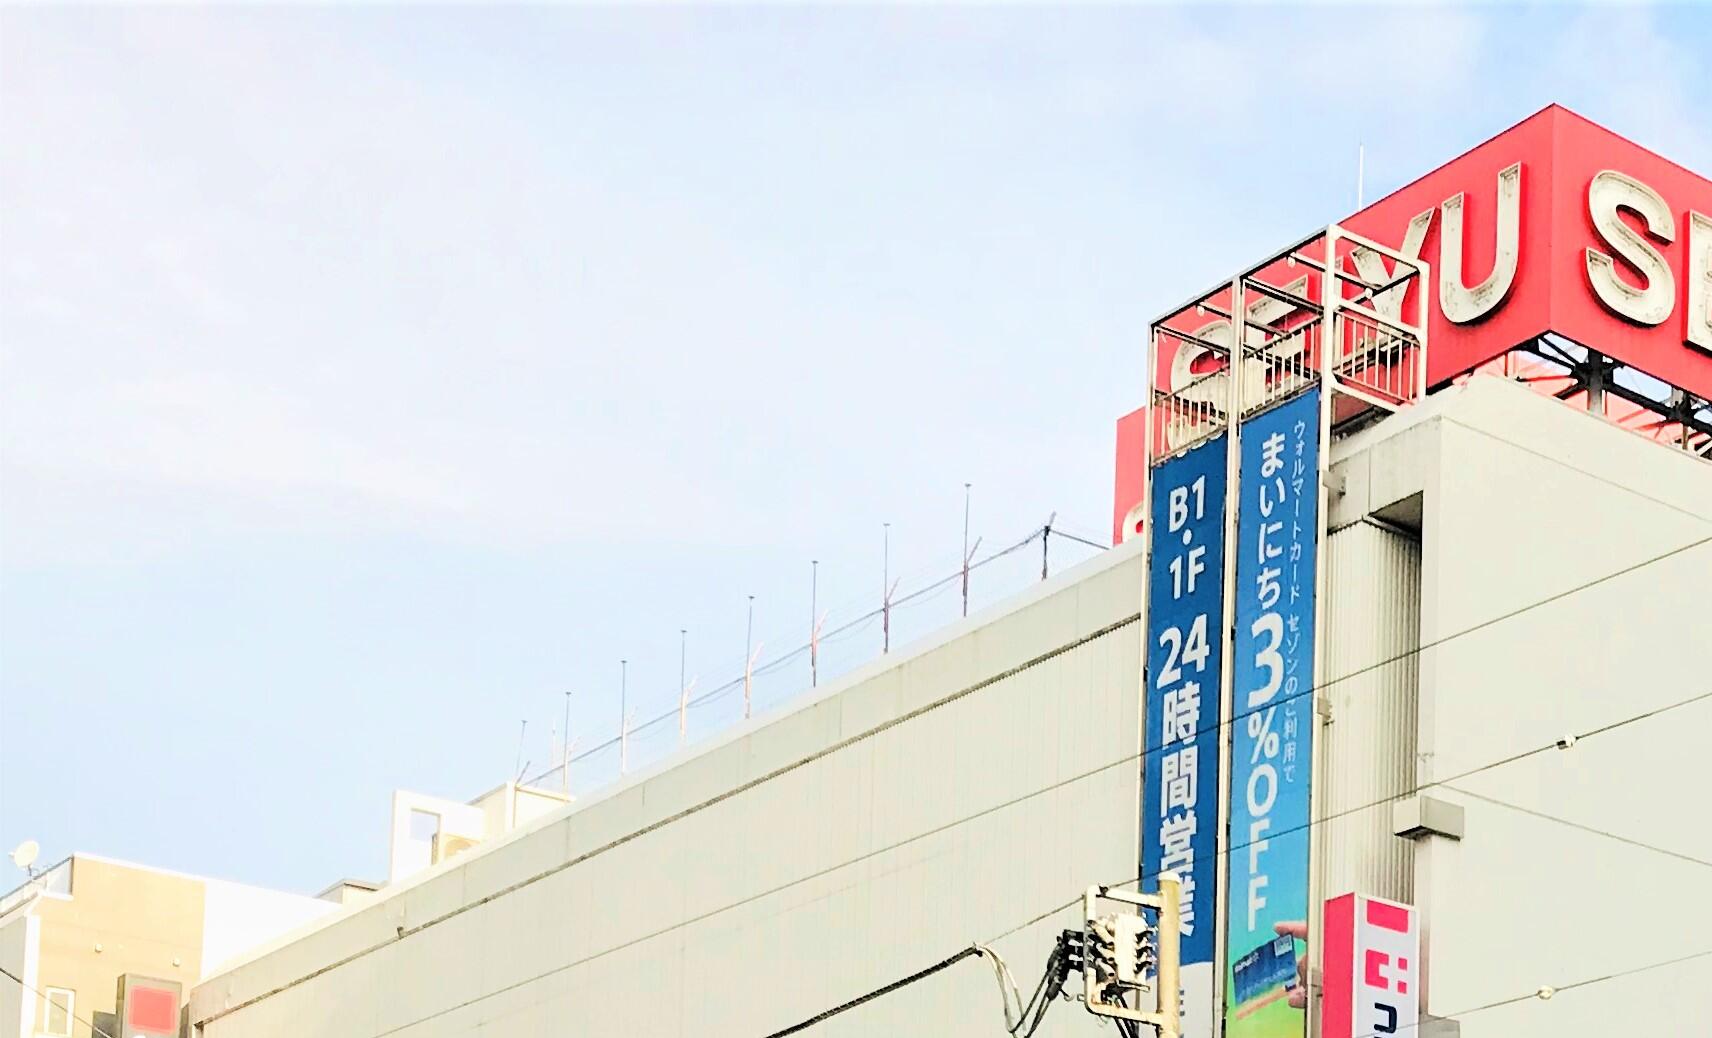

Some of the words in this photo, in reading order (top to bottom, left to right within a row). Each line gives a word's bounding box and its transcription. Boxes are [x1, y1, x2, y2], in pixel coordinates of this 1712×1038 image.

[1289, 420, 1307, 606] ウォルマートカード
